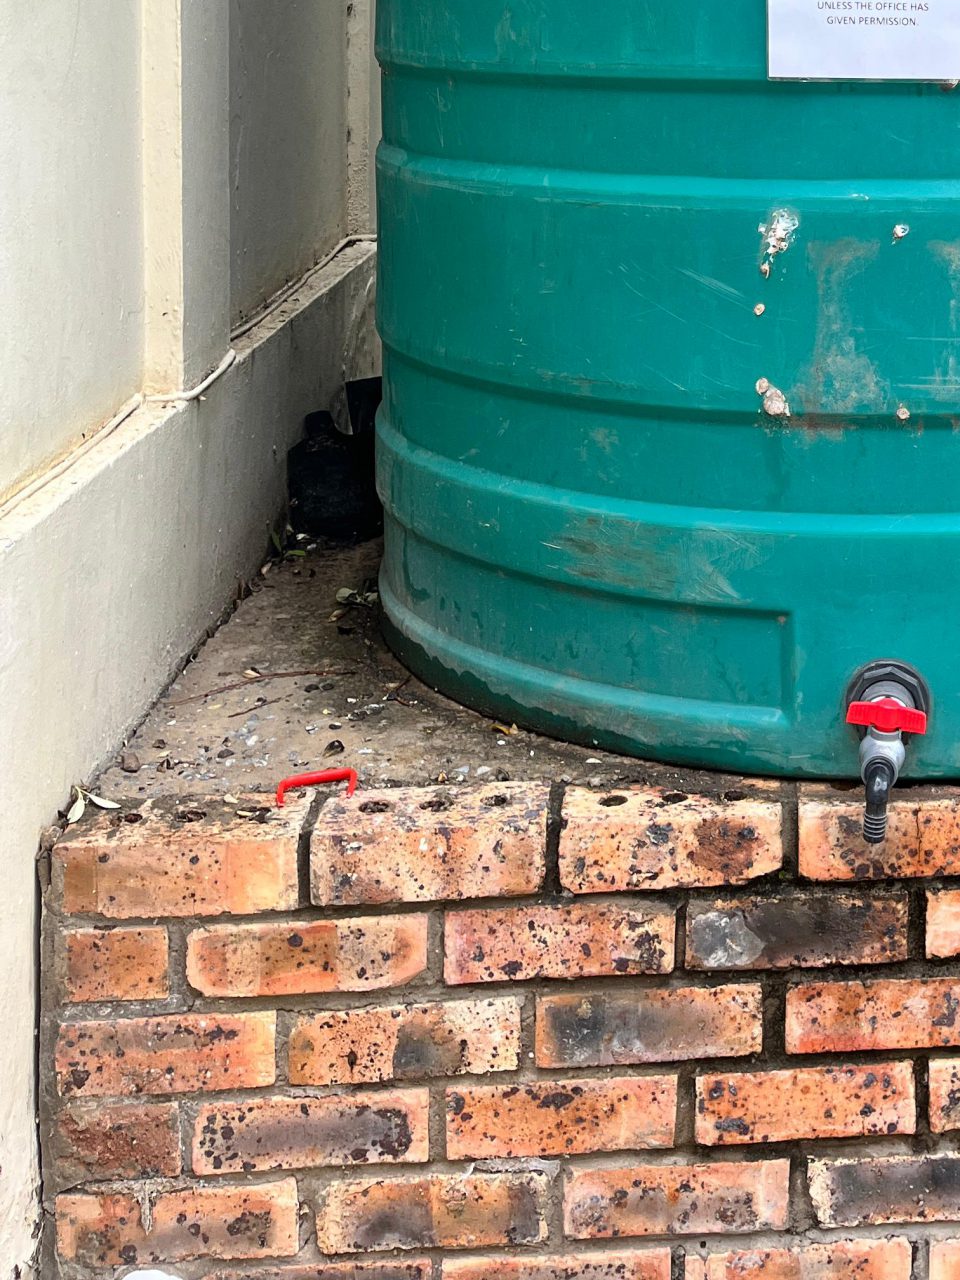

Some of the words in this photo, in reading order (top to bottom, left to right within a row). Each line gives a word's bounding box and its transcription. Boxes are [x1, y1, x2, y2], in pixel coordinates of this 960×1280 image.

[818, 1, 852, 10] UNLESS
[854, 2, 872, 10] THE
[876, 2, 907, 11] OFFICE
[911, 3, 929, 11] HAS
[827, 16, 855, 24] GIVEN
[859, 17, 919, 26] PERMISSION.
